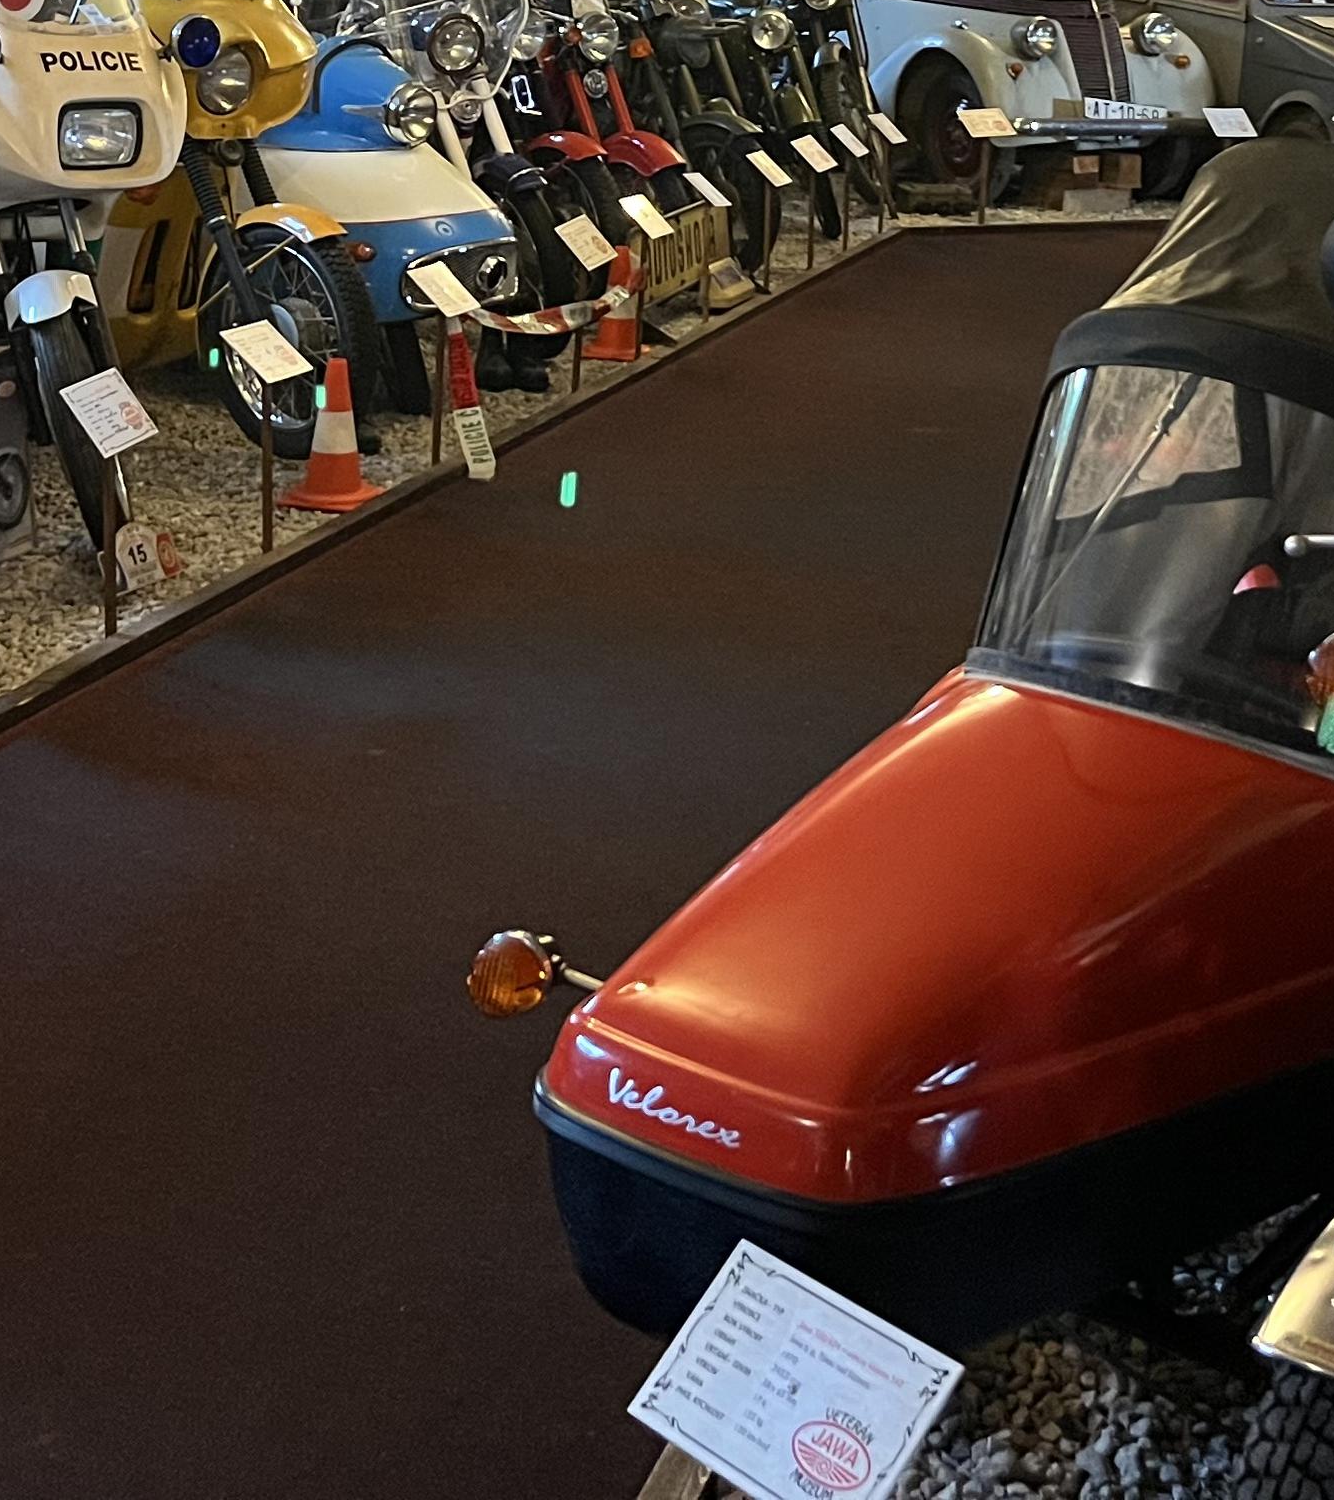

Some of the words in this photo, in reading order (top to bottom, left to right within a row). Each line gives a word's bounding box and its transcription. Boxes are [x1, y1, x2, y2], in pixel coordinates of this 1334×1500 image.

[40, 50, 144, 74] POLICIE
[127, 543, 148, 566] 15
[606, 1066, 742, 1150] Velorex
[825, 1406, 874, 1447] VETERÁN
[810, 1427, 860, 1470] JAWA
